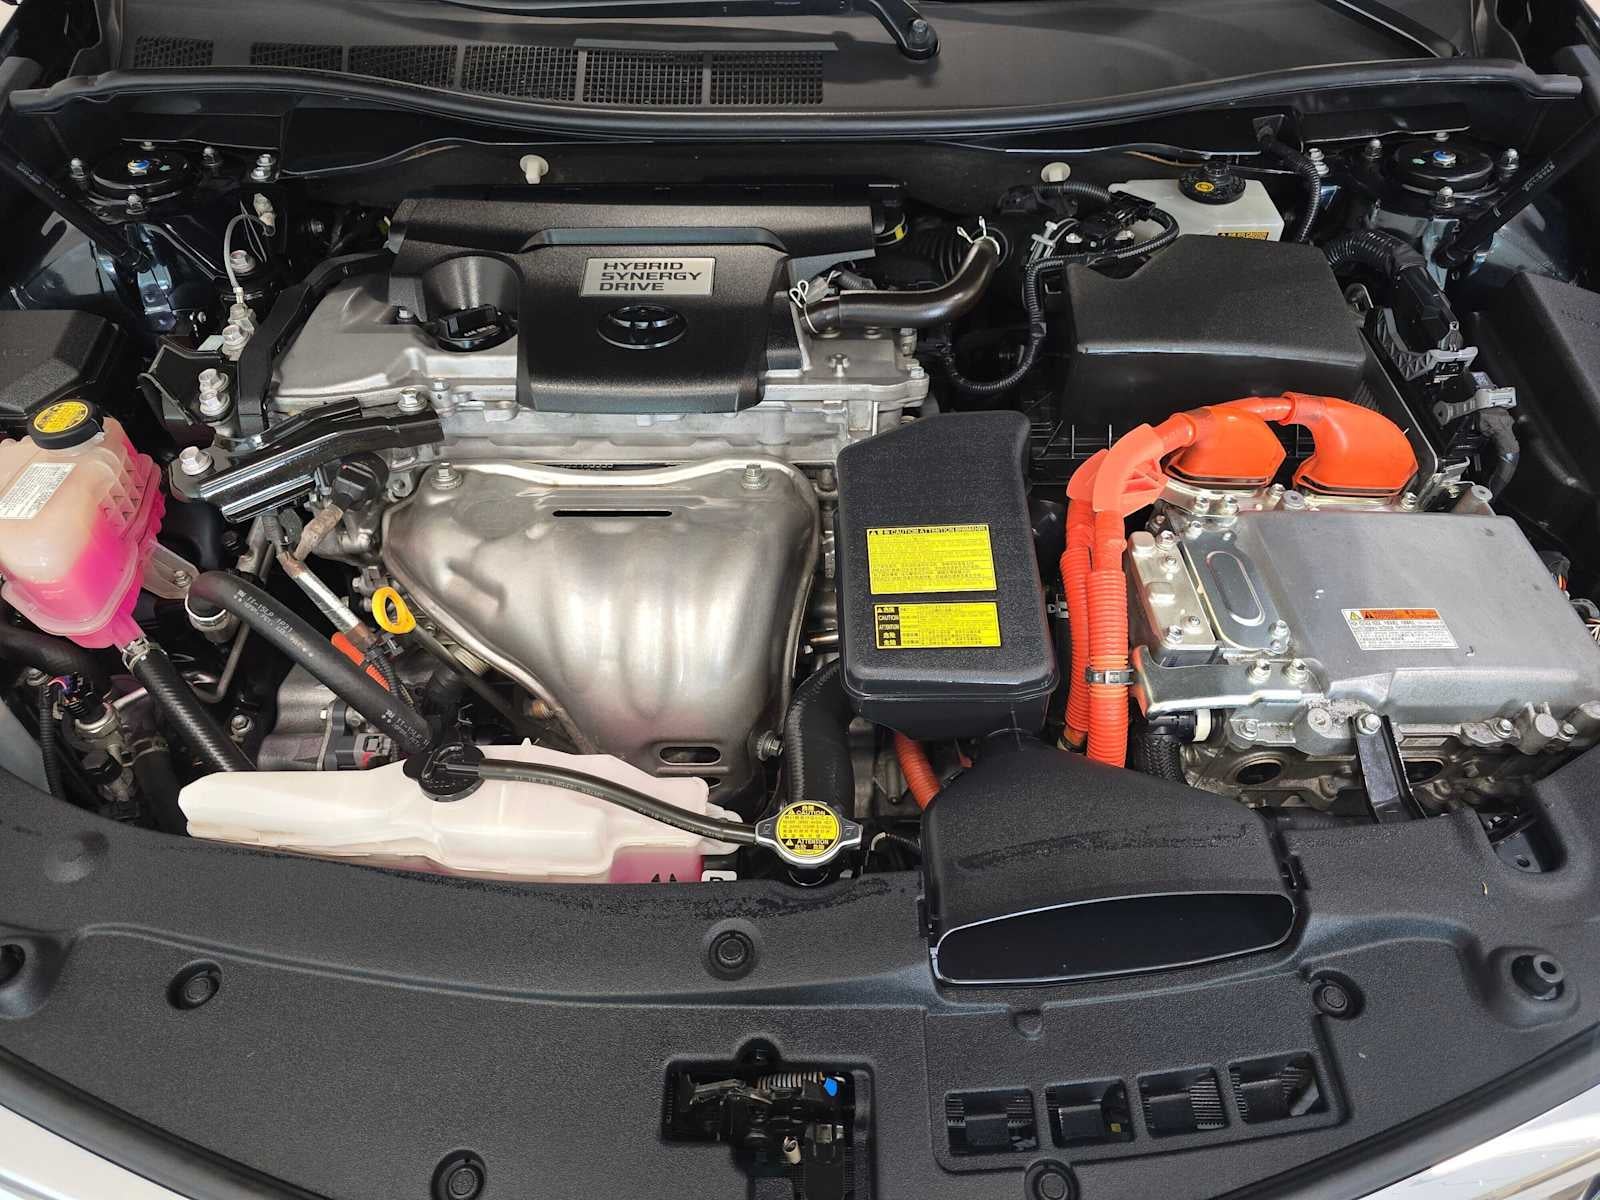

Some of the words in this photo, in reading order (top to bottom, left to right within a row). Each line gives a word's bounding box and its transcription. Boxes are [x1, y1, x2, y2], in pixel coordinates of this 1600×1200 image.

[603, 262, 684, 270] HYBRID
[601, 272, 703, 281] SYNERGY
[599, 282, 665, 291] DRIVE
